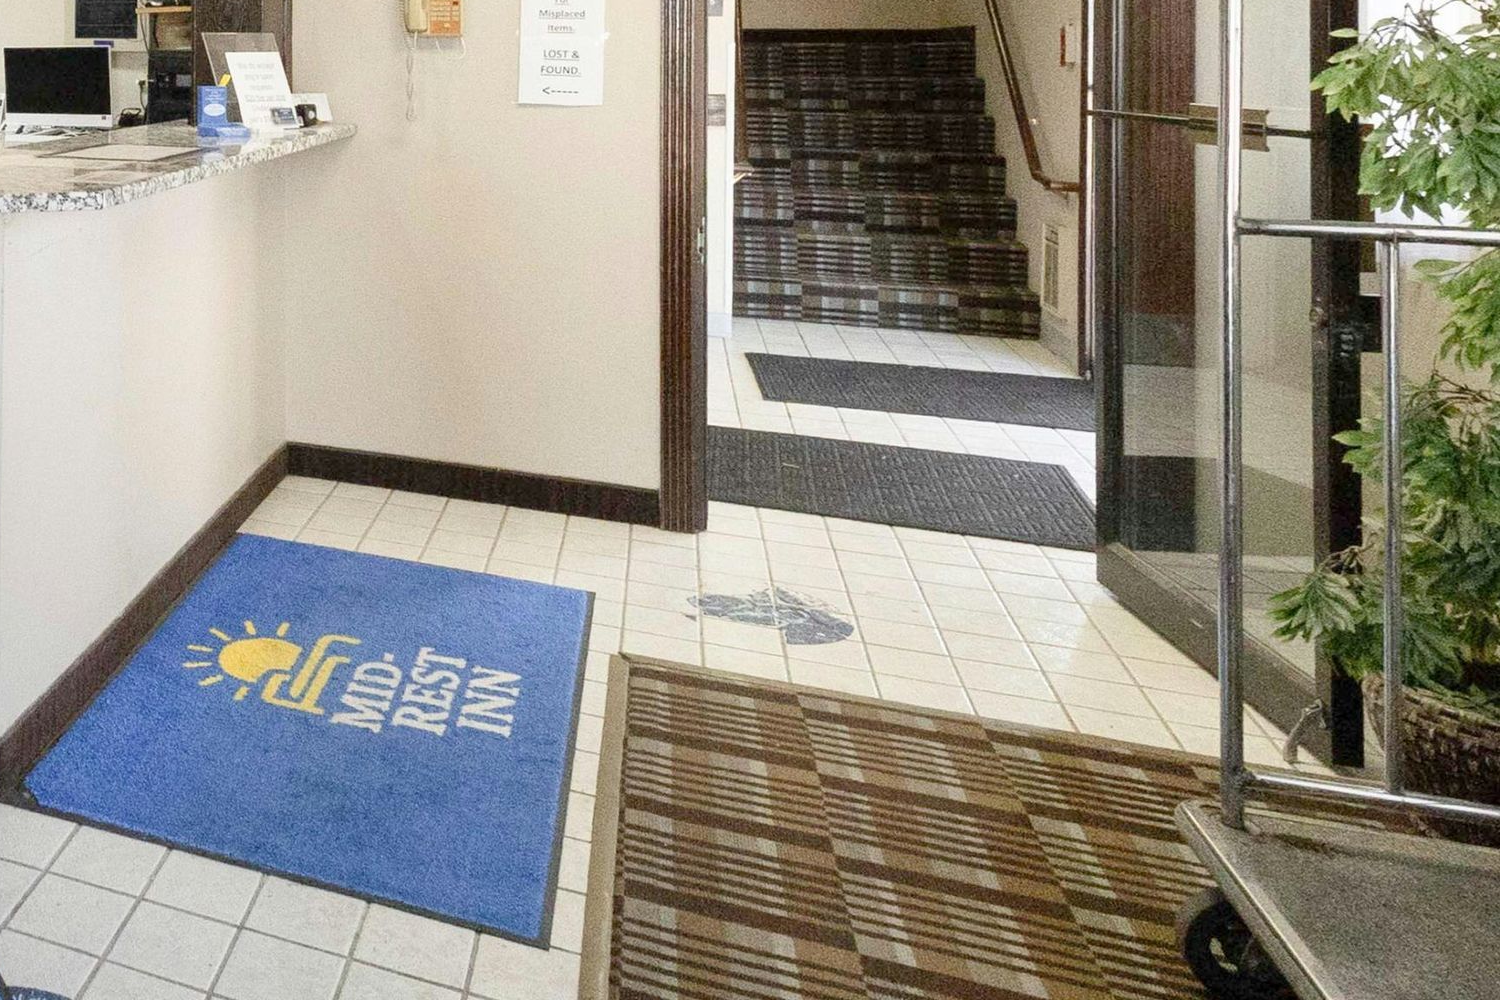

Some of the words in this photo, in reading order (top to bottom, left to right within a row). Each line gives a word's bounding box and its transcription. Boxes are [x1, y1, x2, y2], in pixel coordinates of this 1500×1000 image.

[539, 9, 586, 18] Misplaced
[543, 49, 568, 58] LOST
[571, 50, 580, 59] &
[392, 647, 467, 737] REST
[457, 665, 522, 738] INN
